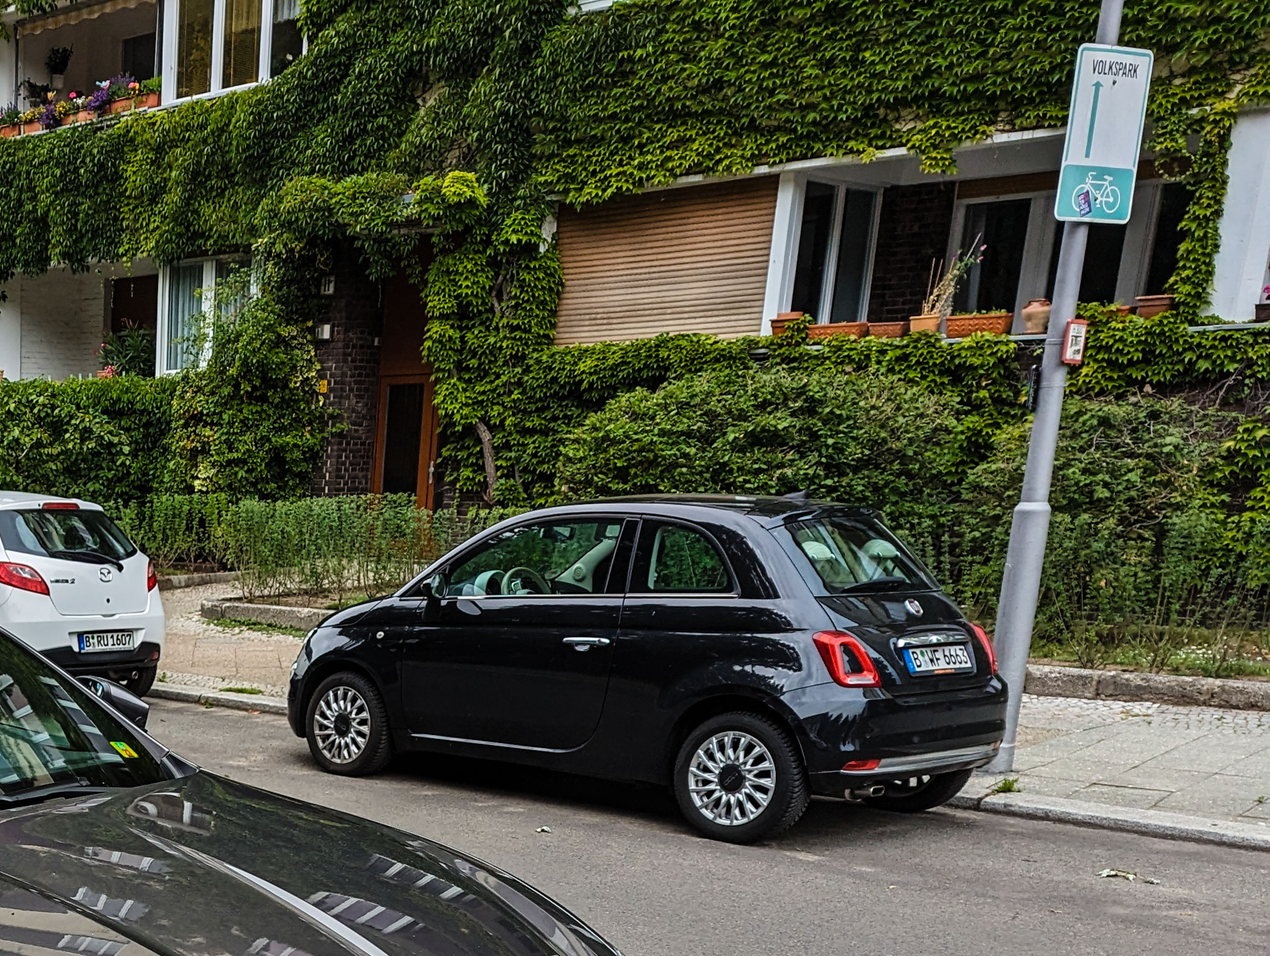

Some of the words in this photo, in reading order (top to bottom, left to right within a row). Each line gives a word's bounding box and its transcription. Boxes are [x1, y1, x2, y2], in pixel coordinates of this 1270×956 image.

[1092, 59, 1139, 79] VOLKSPARK
[84, 635, 92, 648] B
[96, 634, 109, 647] RU
[110, 633, 132, 647] 1607
[911, 650, 922, 668] B
[926, 649, 941, 667] WF
